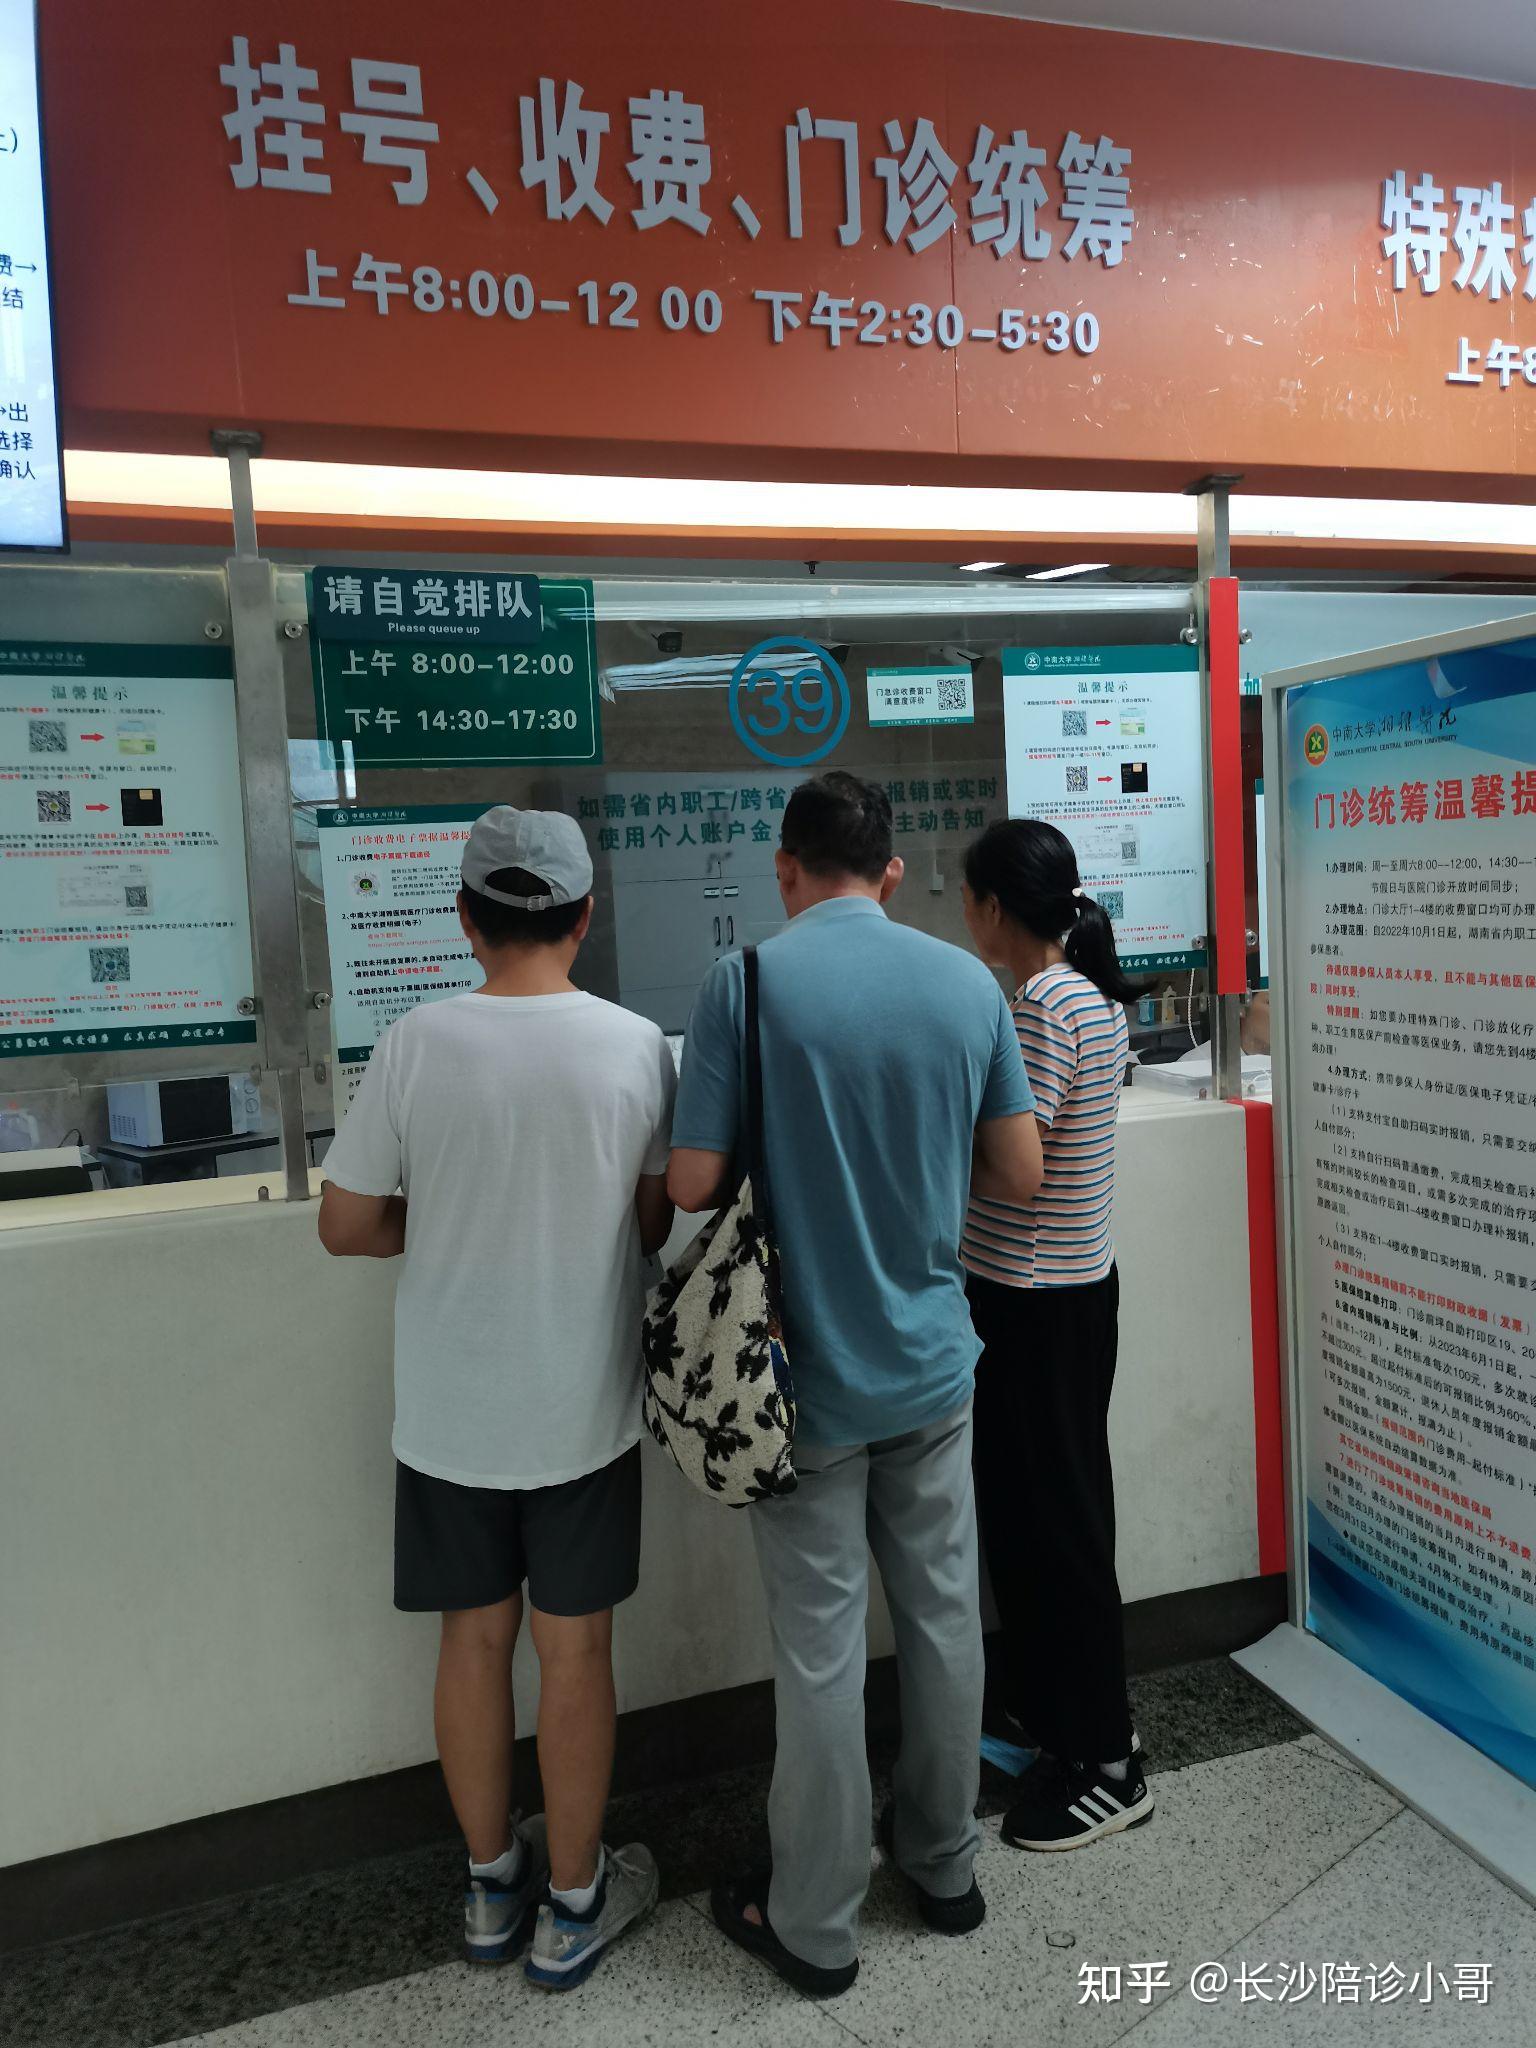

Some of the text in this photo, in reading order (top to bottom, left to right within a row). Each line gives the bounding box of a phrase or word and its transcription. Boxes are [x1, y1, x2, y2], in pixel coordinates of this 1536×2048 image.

[219, 35, 1135, 269] 挂号、收费、门诊统筹
[755, 289, 1100, 357] 下午2:30-5:30
[9, 402, 29, 422] 出
[323, 575, 533, 619] 请自觉排队
[388, 622, 481, 636] Please queue up
[341, 649, 575, 677] 上午 8:00-12:00
[52, 685, 128, 701] 温馨提示
[875, 686, 933, 698] 门急诊收费窗口
[1077, 680, 1128, 693] 温馨提示
[746, 668, 834, 737] 39
[884, 696, 926, 707] 满意度评价
[344, 707, 578, 734] 下午 14:30-17:30
[577, 776, 999, 820] 如需省内职工/跨省 报销或实时
[597, 806, 985, 851] 使用个人账户金 主动告知
